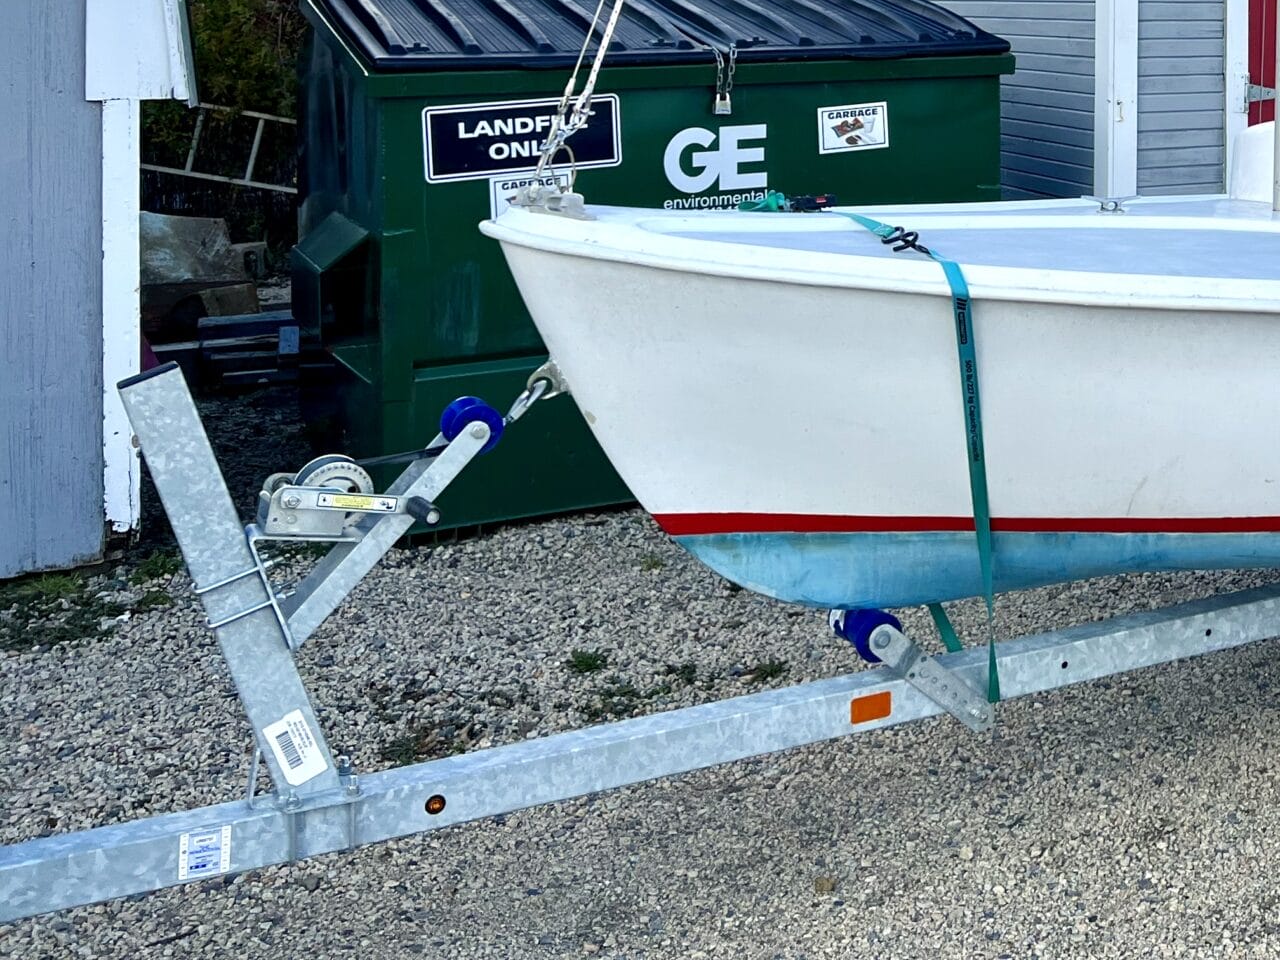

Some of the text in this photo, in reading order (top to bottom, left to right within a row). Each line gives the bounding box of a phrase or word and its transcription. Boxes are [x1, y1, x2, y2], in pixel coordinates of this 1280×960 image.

[827, 108, 878, 120] GARBAGE
[488, 139, 557, 160] ONL
[663, 124, 768, 194] GE
[501, 177, 561, 191] GARAG
[663, 189, 769, 211] environmental
